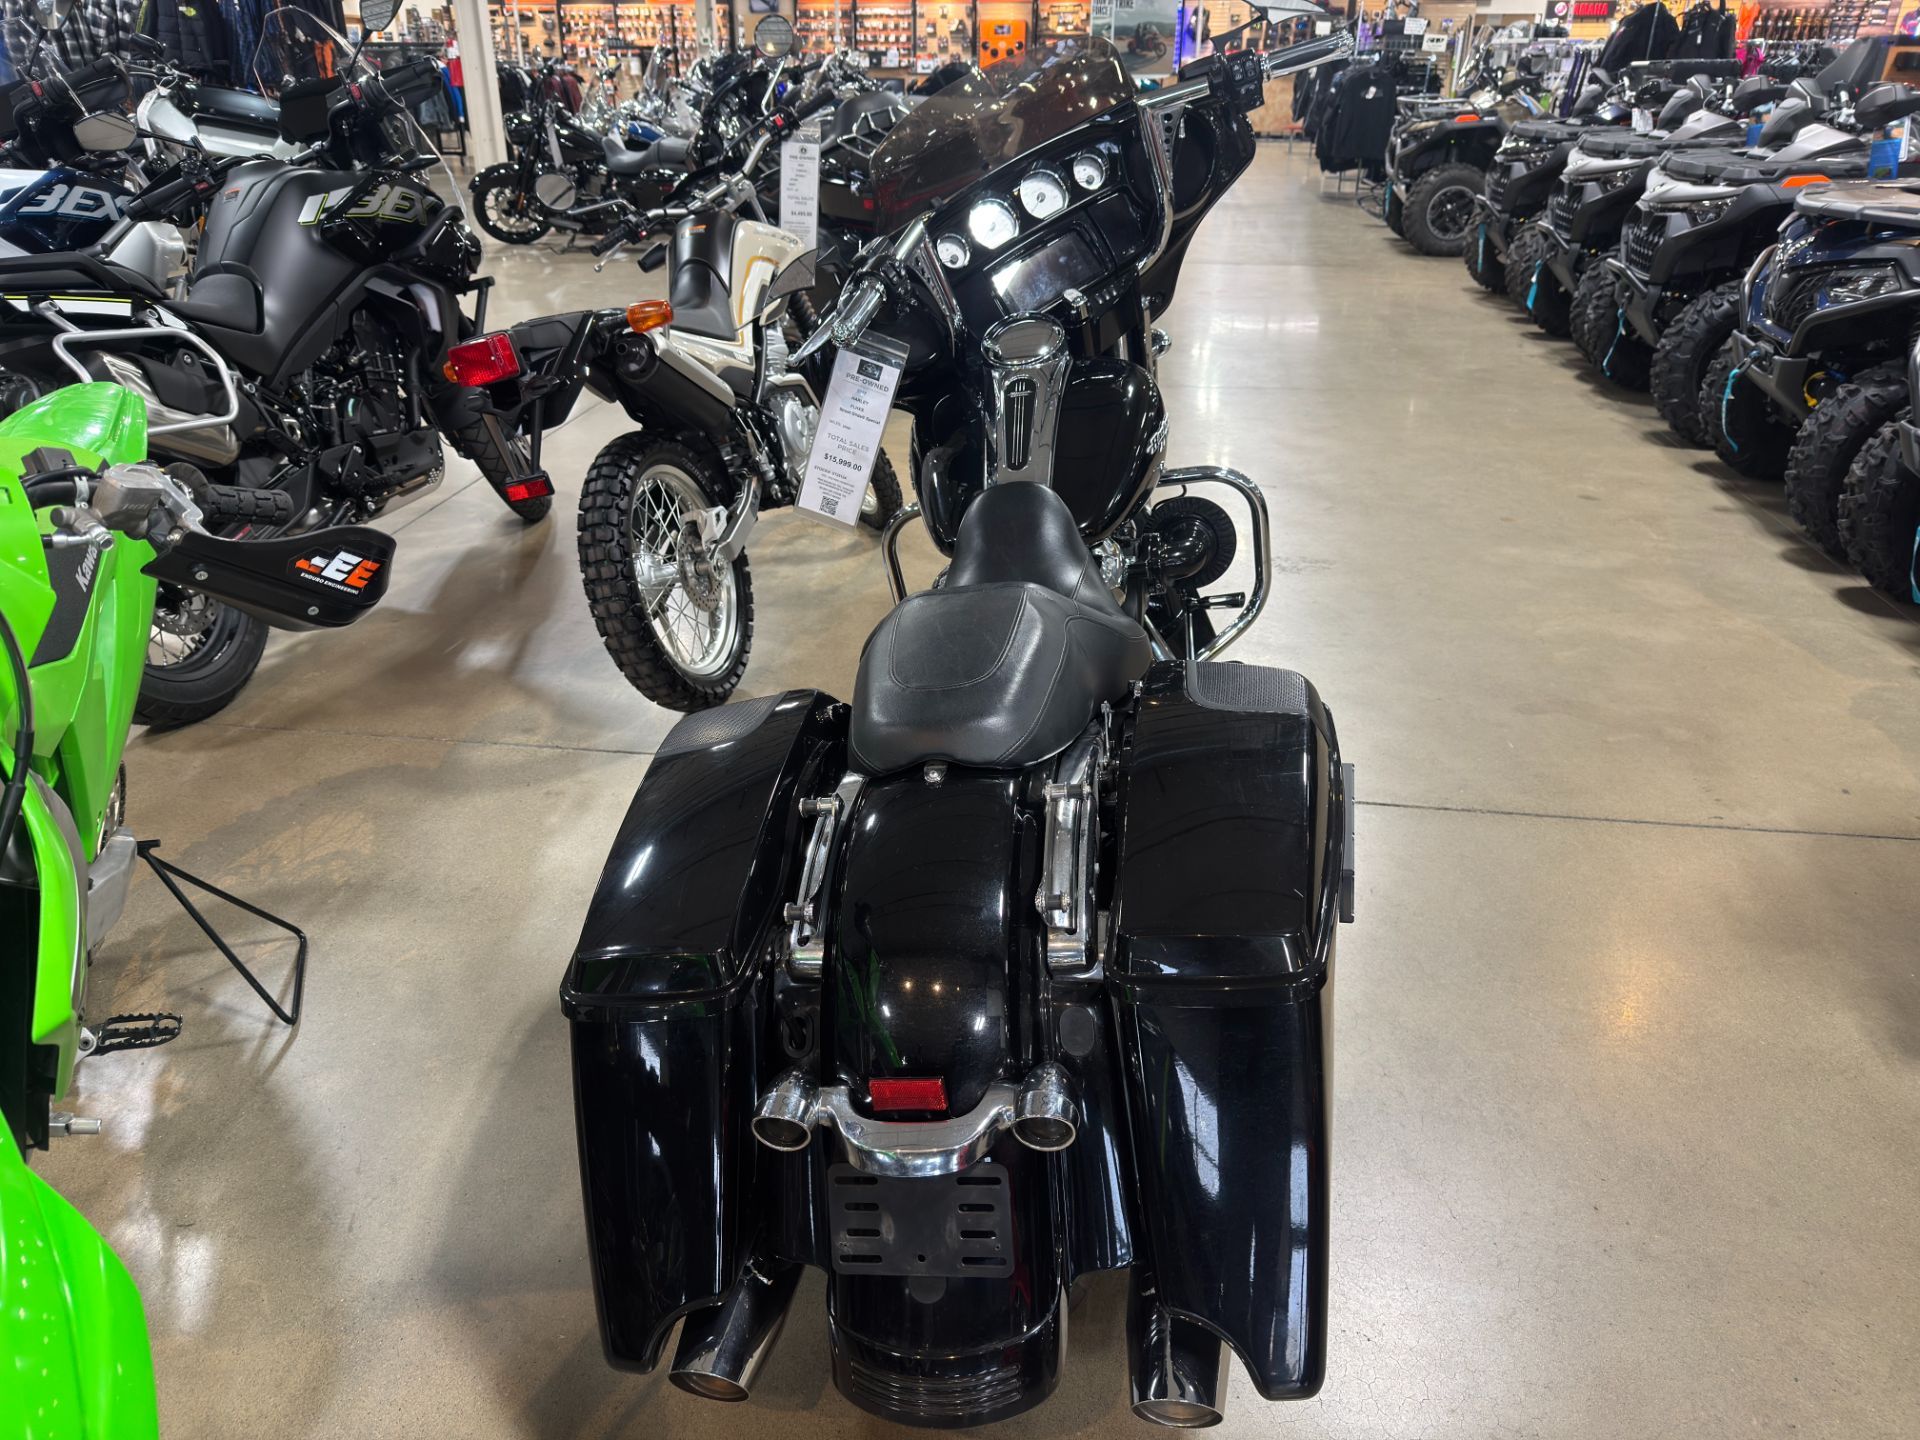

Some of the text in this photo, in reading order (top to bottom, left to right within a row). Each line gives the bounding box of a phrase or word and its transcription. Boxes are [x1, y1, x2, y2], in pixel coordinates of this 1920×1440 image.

[846, 372, 890, 392] PRE-OWNED
[827, 432, 870, 452] TOTAL SALES
[837, 443, 857, 455] PRICE
[823, 452, 863, 472] $15,999.00
[300, 571, 359, 596] ENDURO ENGINEERING
